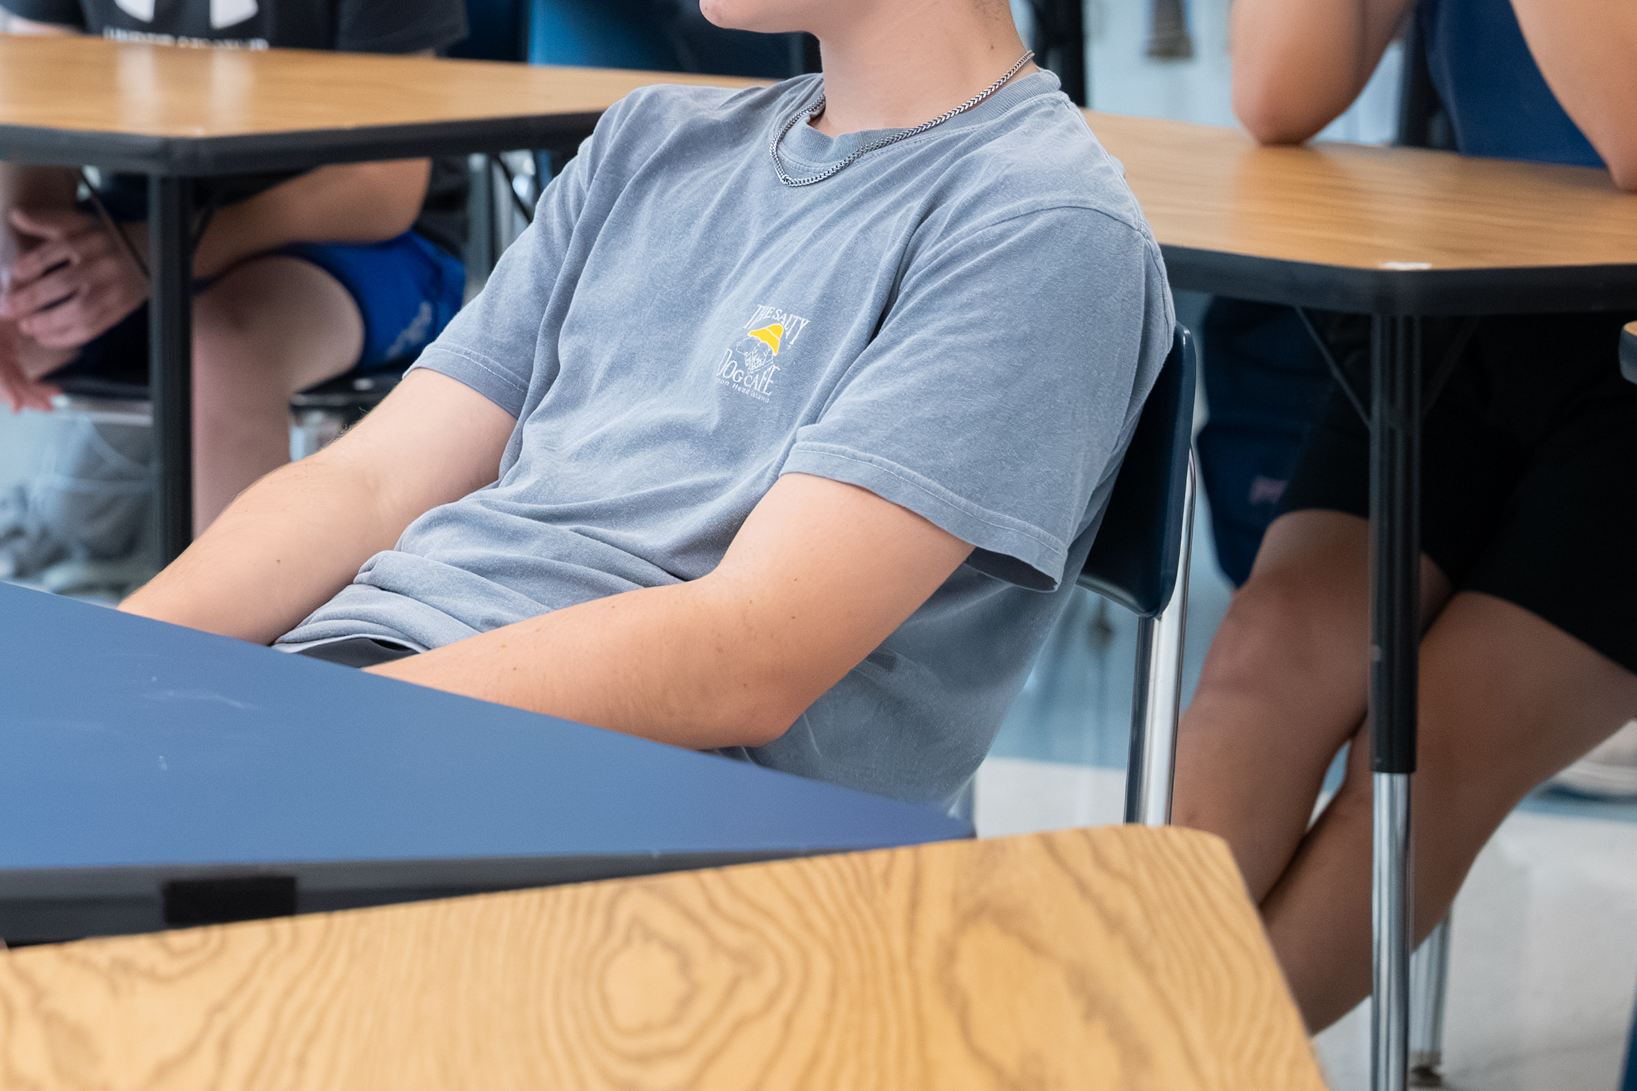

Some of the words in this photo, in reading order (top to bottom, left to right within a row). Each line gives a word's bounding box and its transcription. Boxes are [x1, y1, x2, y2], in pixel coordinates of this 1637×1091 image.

[743, 304, 775, 329] THE
[771, 308, 811, 346] SALTY
[715, 348, 744, 383] DOG
